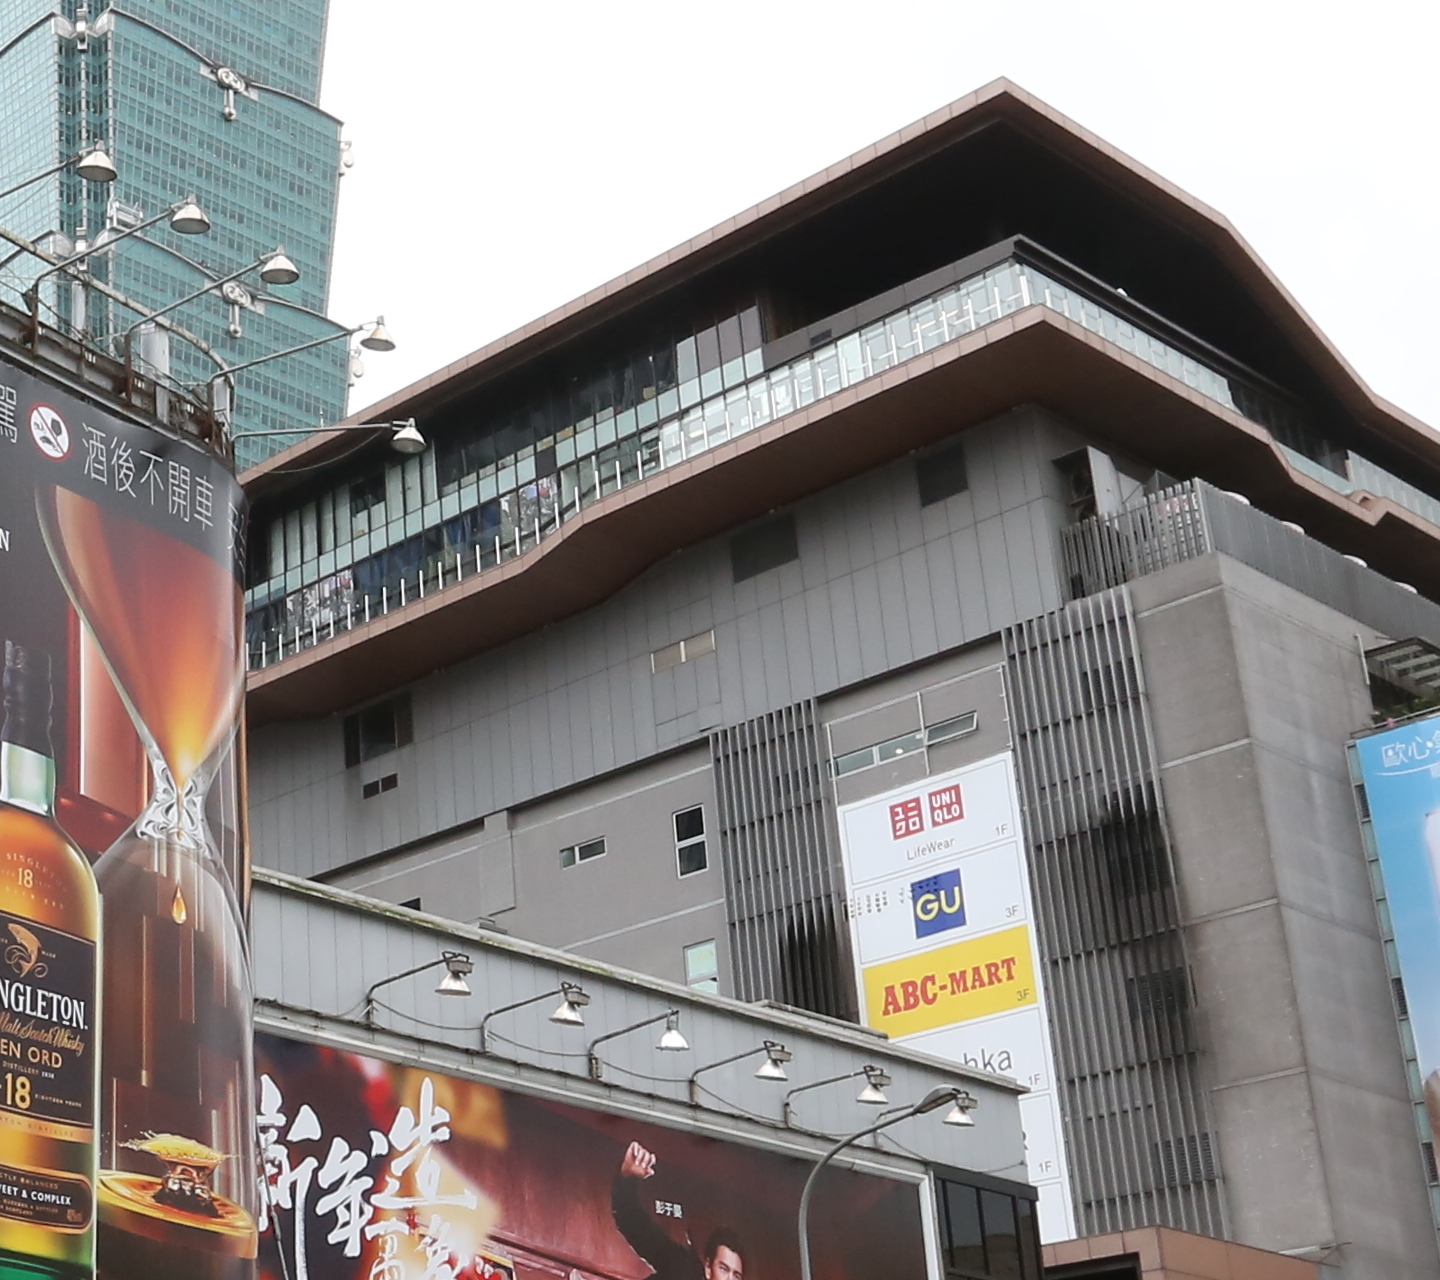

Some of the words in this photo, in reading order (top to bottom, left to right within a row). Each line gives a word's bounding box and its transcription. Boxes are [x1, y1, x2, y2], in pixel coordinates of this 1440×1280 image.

[82, 422, 215, 532] 酒後不開車
[931, 789, 958, 808] UNI
[934, 804, 961, 824] QLO
[996, 823, 1009, 836] 1F
[907, 836, 956, 861] LifeWear
[17, 867, 34, 889] 18
[916, 885, 962, 922] GU
[1005, 904, 1020, 919] 3F
[882, 956, 1017, 1017] ABC-MART
[1016, 988, 1031, 1003] 3F
[27, 1045, 63, 1069] ORD
[1028, 1073, 1042, 1087] 1F
[5, 1072, 31, 1110] 18
[1038, 1160, 1053, 1175] 1F
[21, 1188, 29, 1199] &
[30, 1190, 73, 1207] COMPLEX
